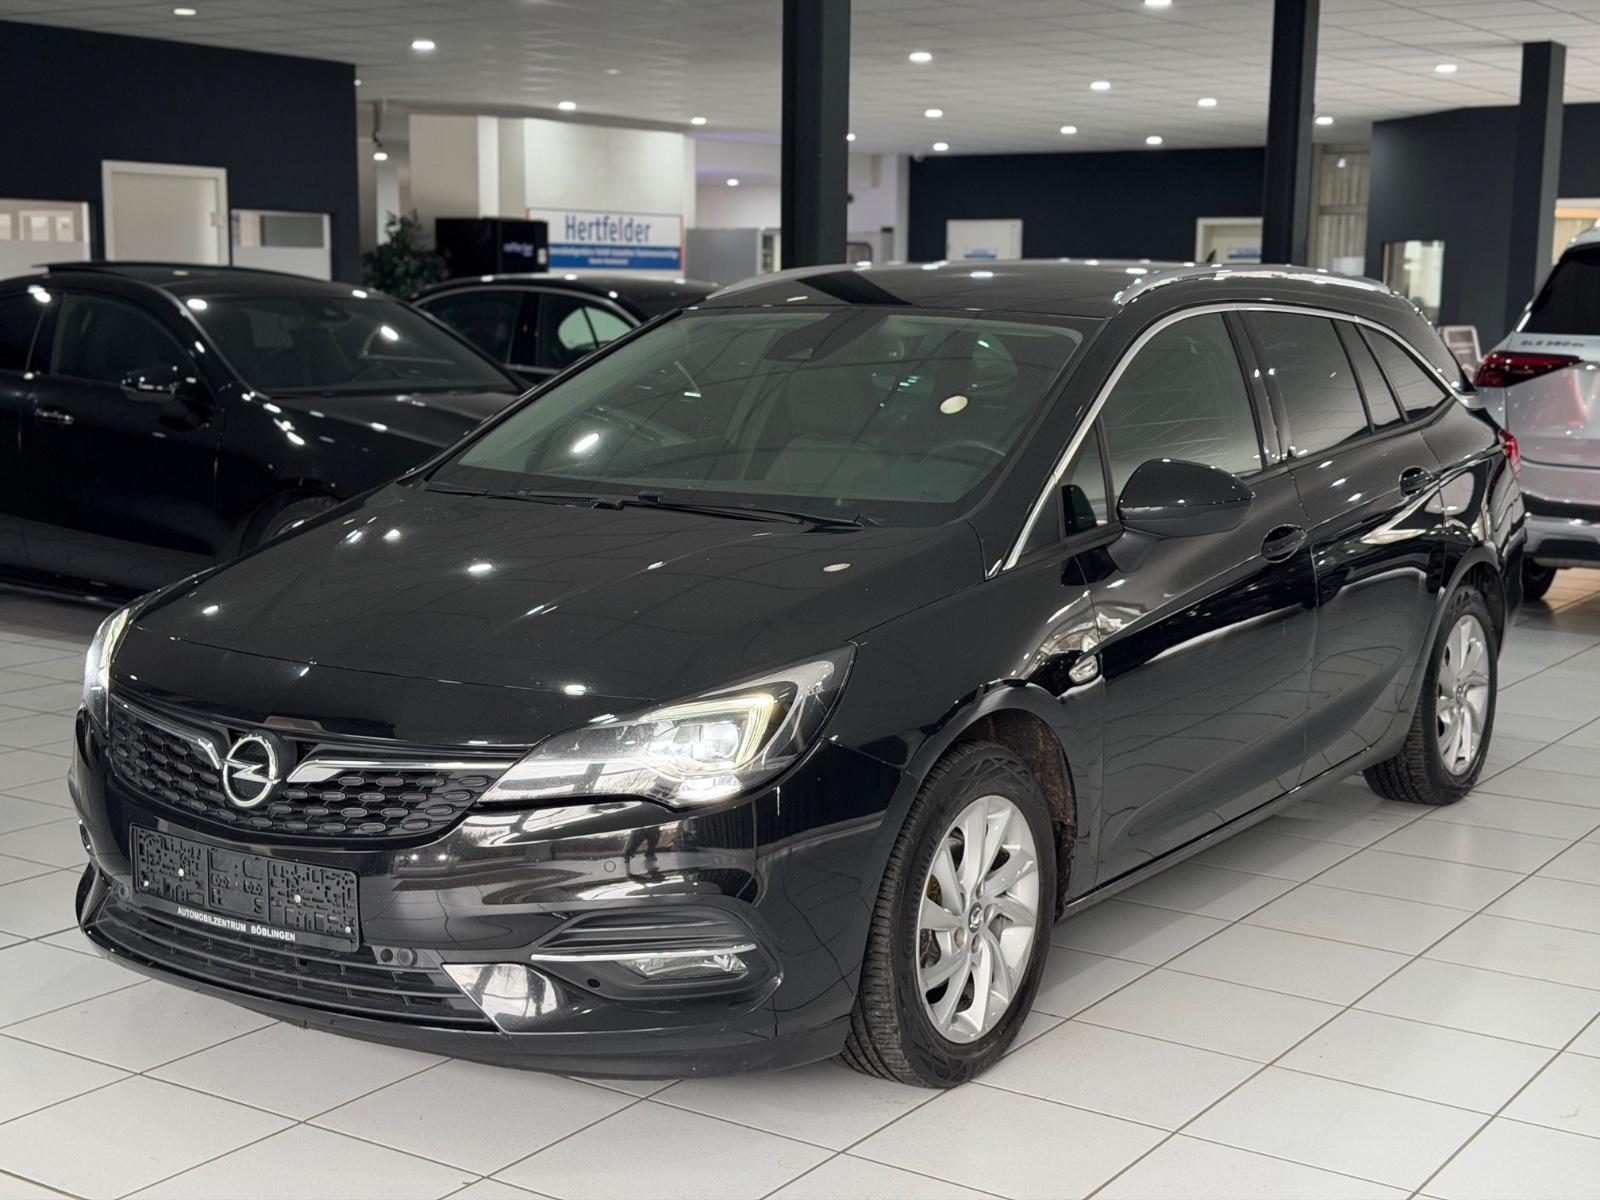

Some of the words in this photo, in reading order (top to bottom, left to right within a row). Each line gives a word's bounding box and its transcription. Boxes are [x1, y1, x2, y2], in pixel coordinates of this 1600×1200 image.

[565, 214, 652, 242] Hertfelder
[177, 905, 247, 932] AUTOMOBILZENTRUM
[250, 924, 296, 941] BÖBLINGEN
